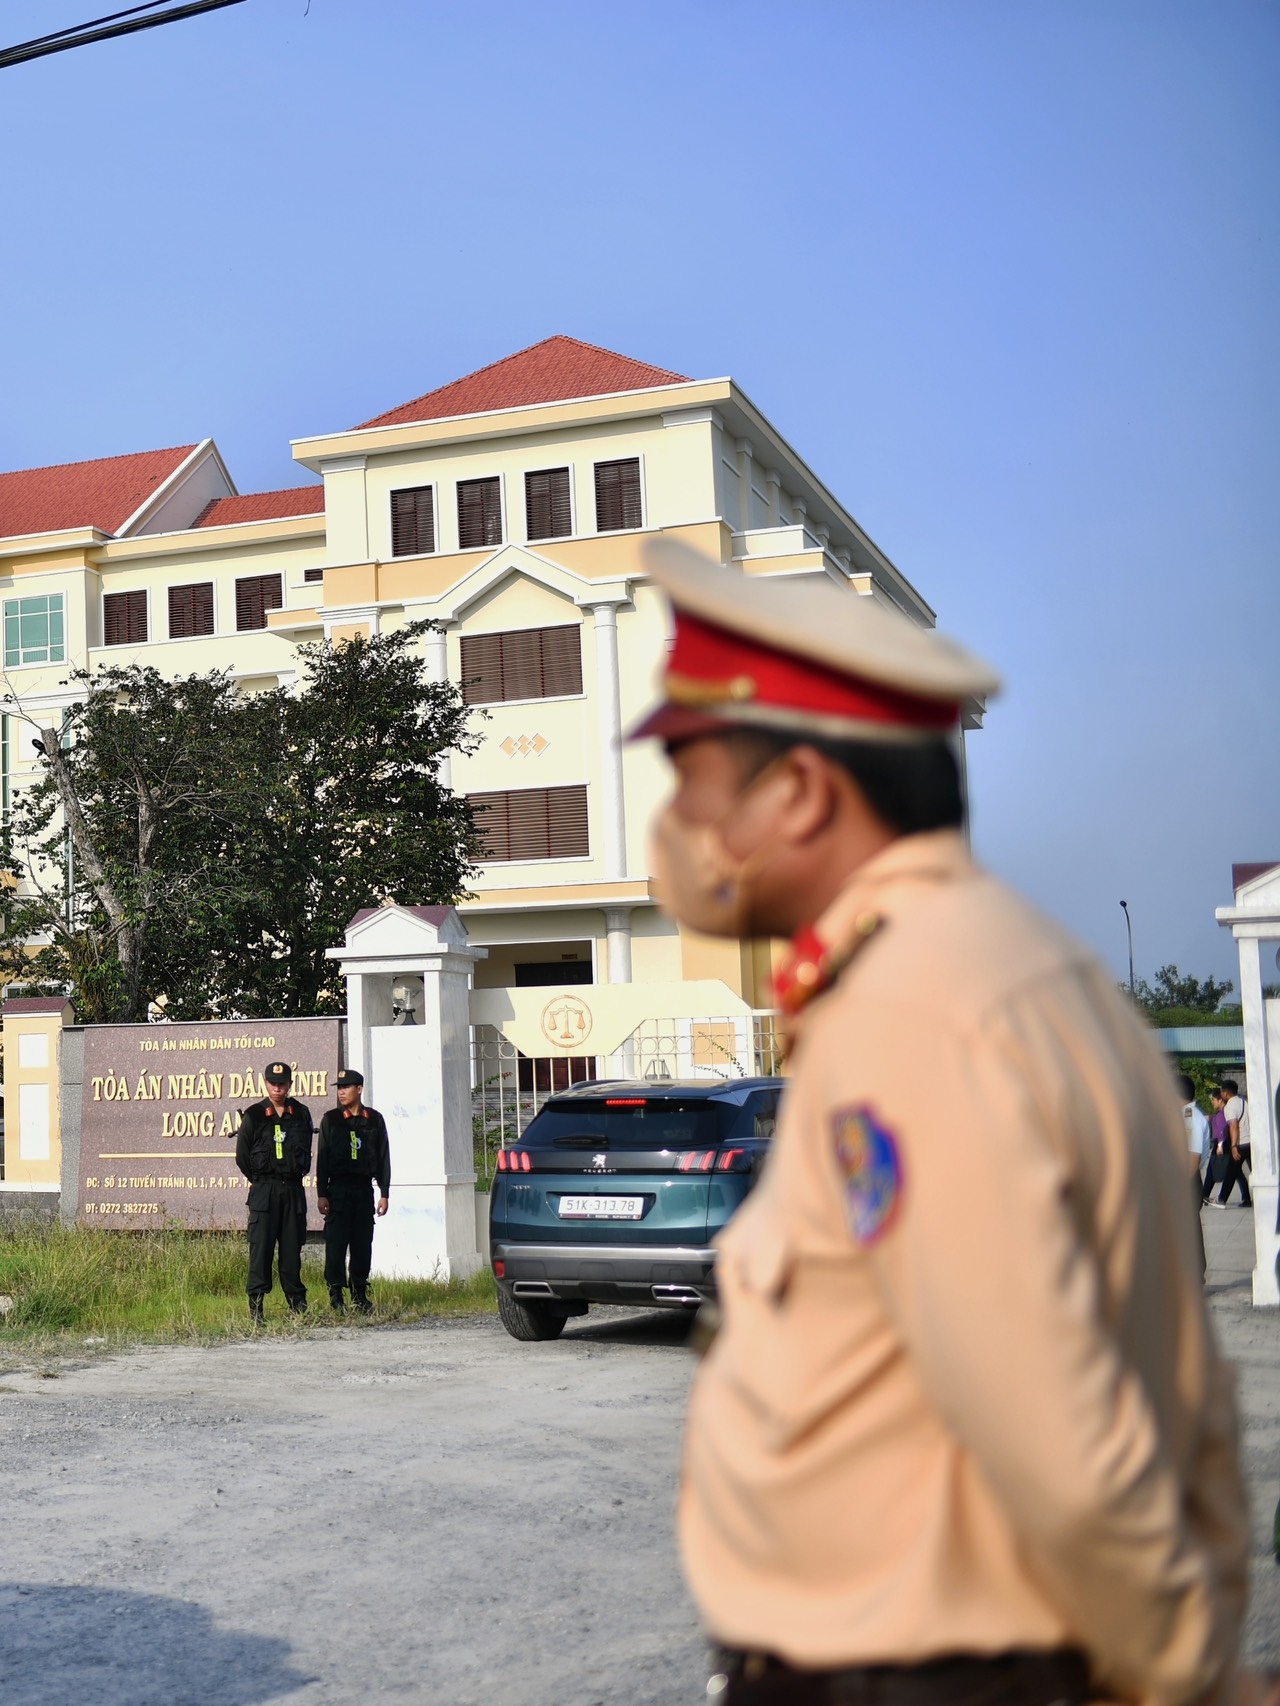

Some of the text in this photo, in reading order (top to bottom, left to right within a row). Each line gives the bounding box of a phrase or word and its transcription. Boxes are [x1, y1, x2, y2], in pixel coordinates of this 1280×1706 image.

[139, 1033, 276, 1051] TÒA ÁN NHÂN DÂN TỐI CAO
[91, 1068, 131, 1102] TÒA
[133, 1068, 164, 1101] ÁN
[167, 1067, 224, 1099] NHÂN
[289, 1061, 328, 1096] ỈNH
[162, 1110, 215, 1137] LONG
[104, 1174, 117, 1188] SỐ
[117, 1177, 128, 1188] 12
[130, 1174, 156, 1188] TUYẾN
[157, 1173, 185, 1188] TRÁNH
[187, 1177, 198, 1189] QL
[200, 1177, 208, 1190] 1,
[100, 1203, 120, 1214] 0272
[122, 1203, 158, 1214] 3827275
